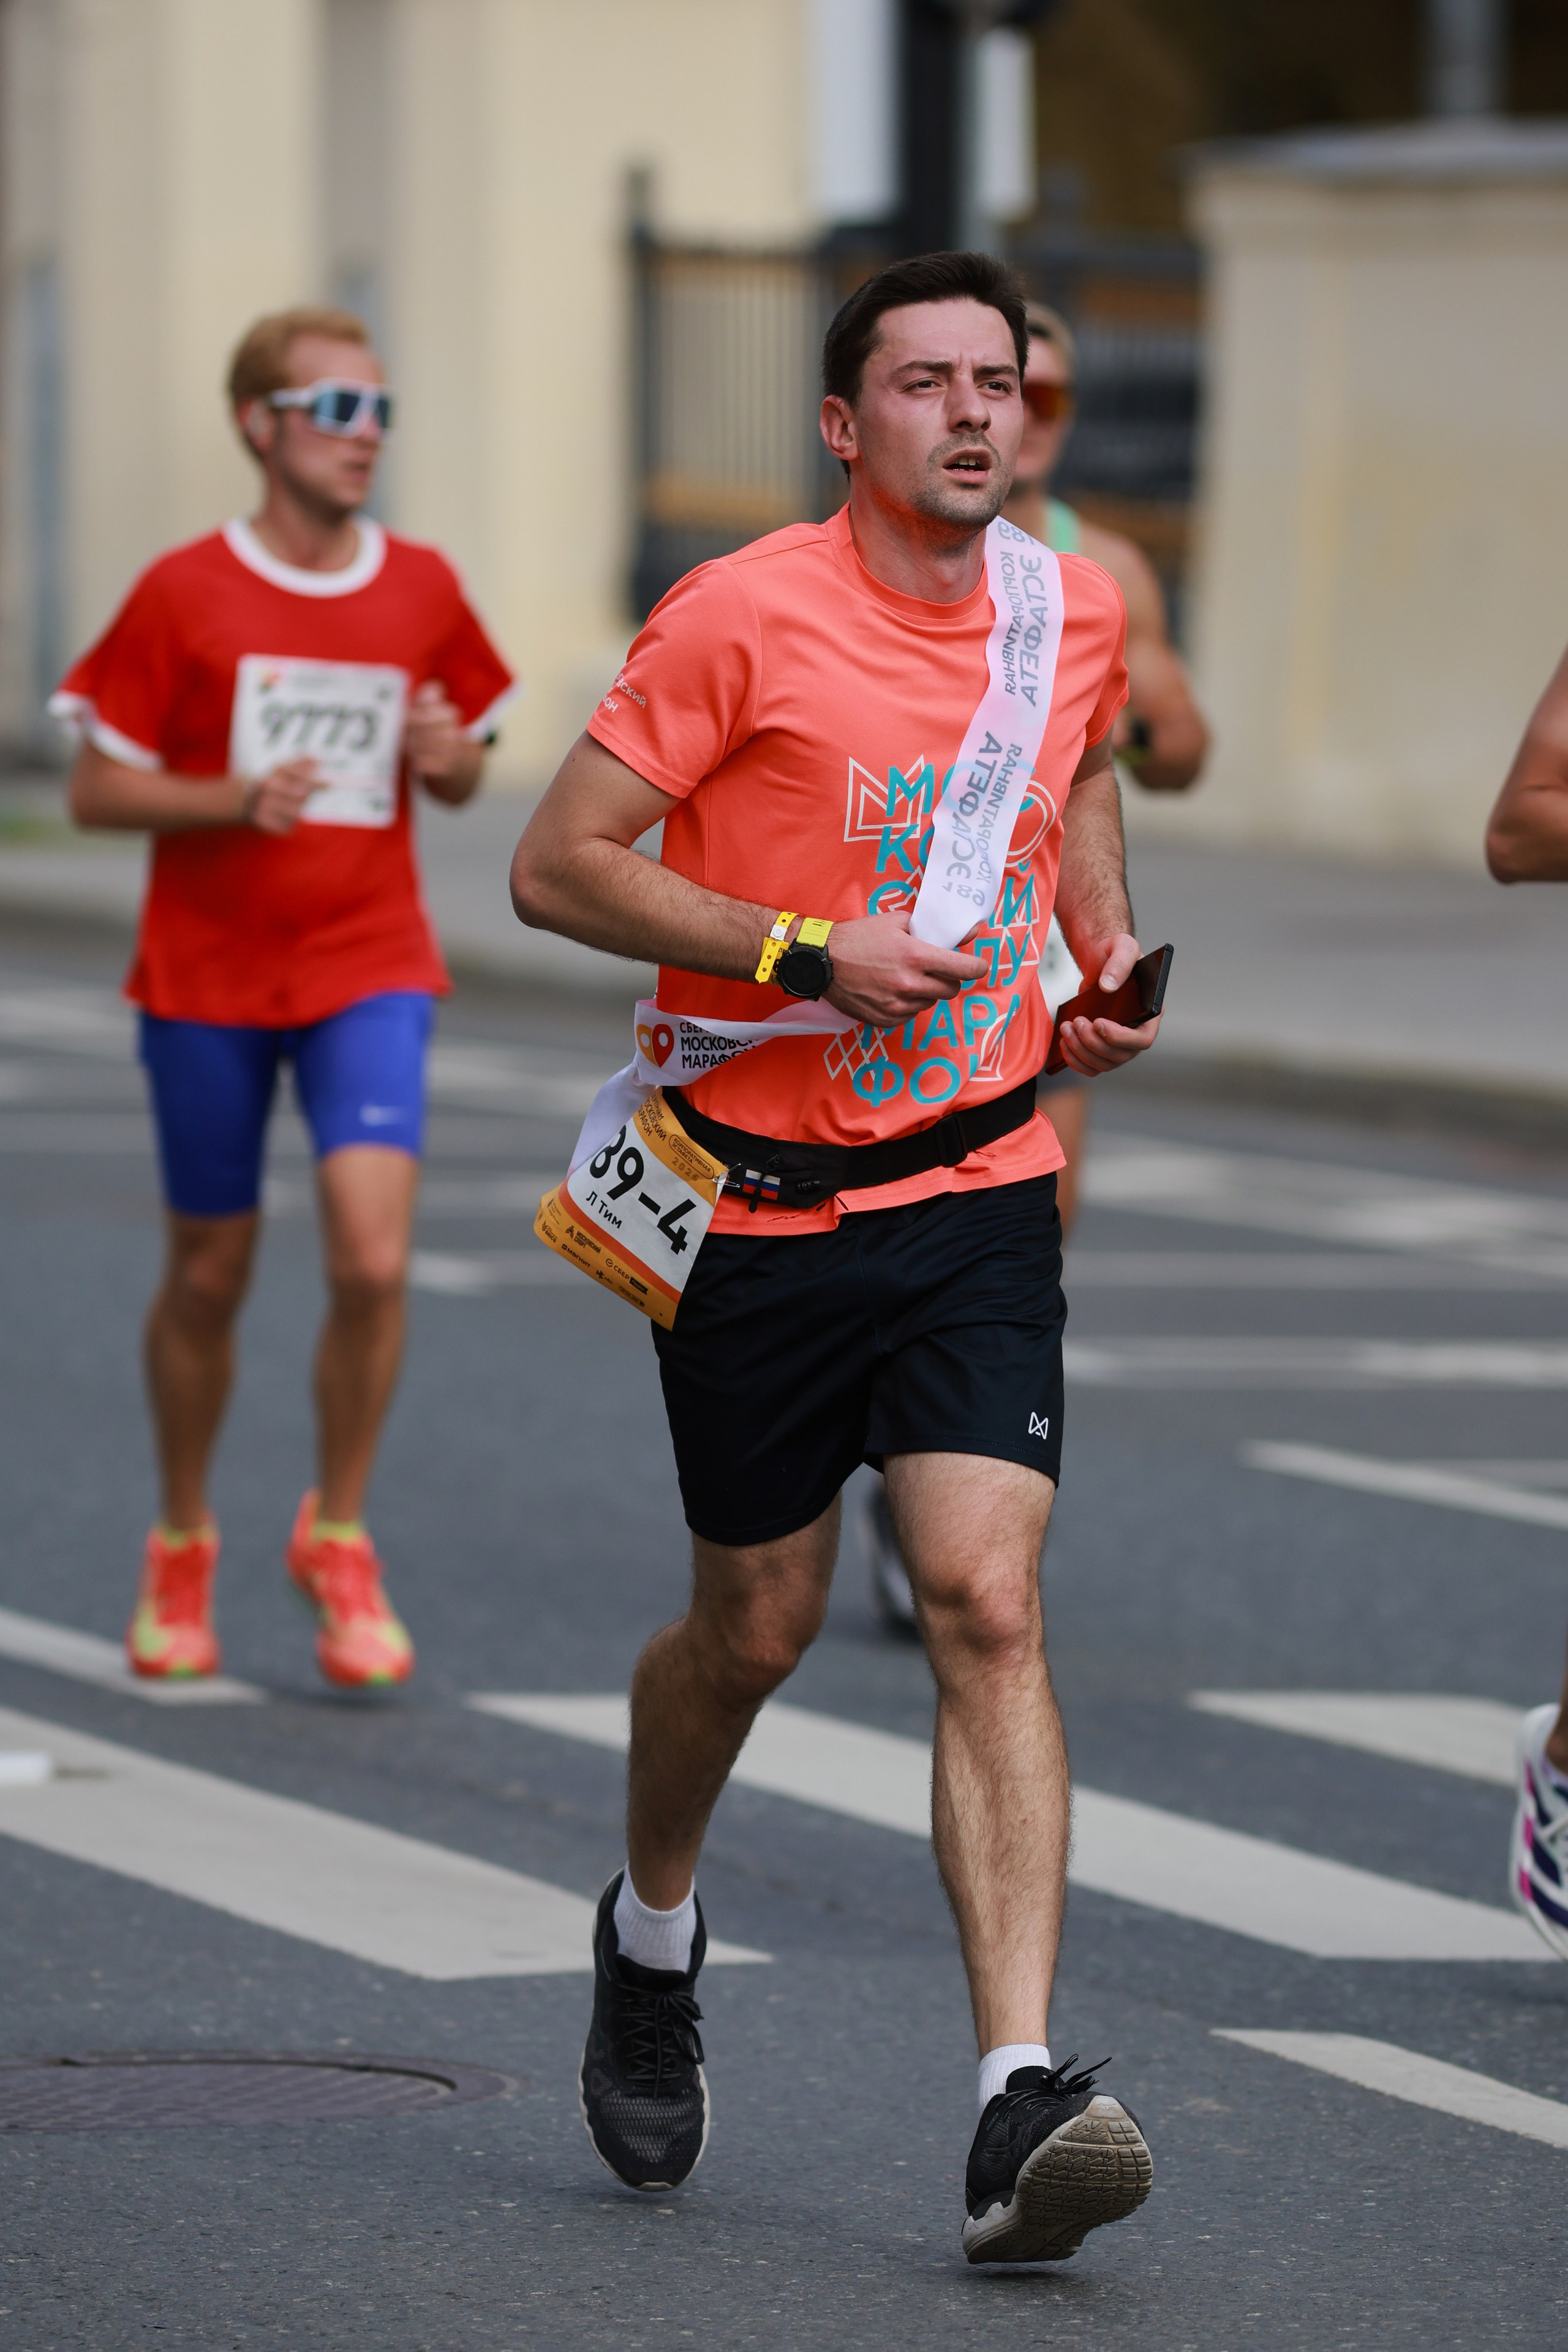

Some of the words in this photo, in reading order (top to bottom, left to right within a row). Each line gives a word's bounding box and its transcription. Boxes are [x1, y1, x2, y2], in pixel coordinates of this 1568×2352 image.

[259, 701, 379, 752] 9773
[638, 1105, 652, 1136] АРАФОН
[644, 1098, 666, 1141] ОСКОВСКИЙ
[671, 1143, 693, 1164] ЭСТАФЕТА
[673, 1137, 711, 1172] КОРПОРАТИВНАЯ
[586, 1191, 598, 1207] Л
[598, 1199, 622, 1229] Тим
[613, 1265, 630, 1280] СБЕР
